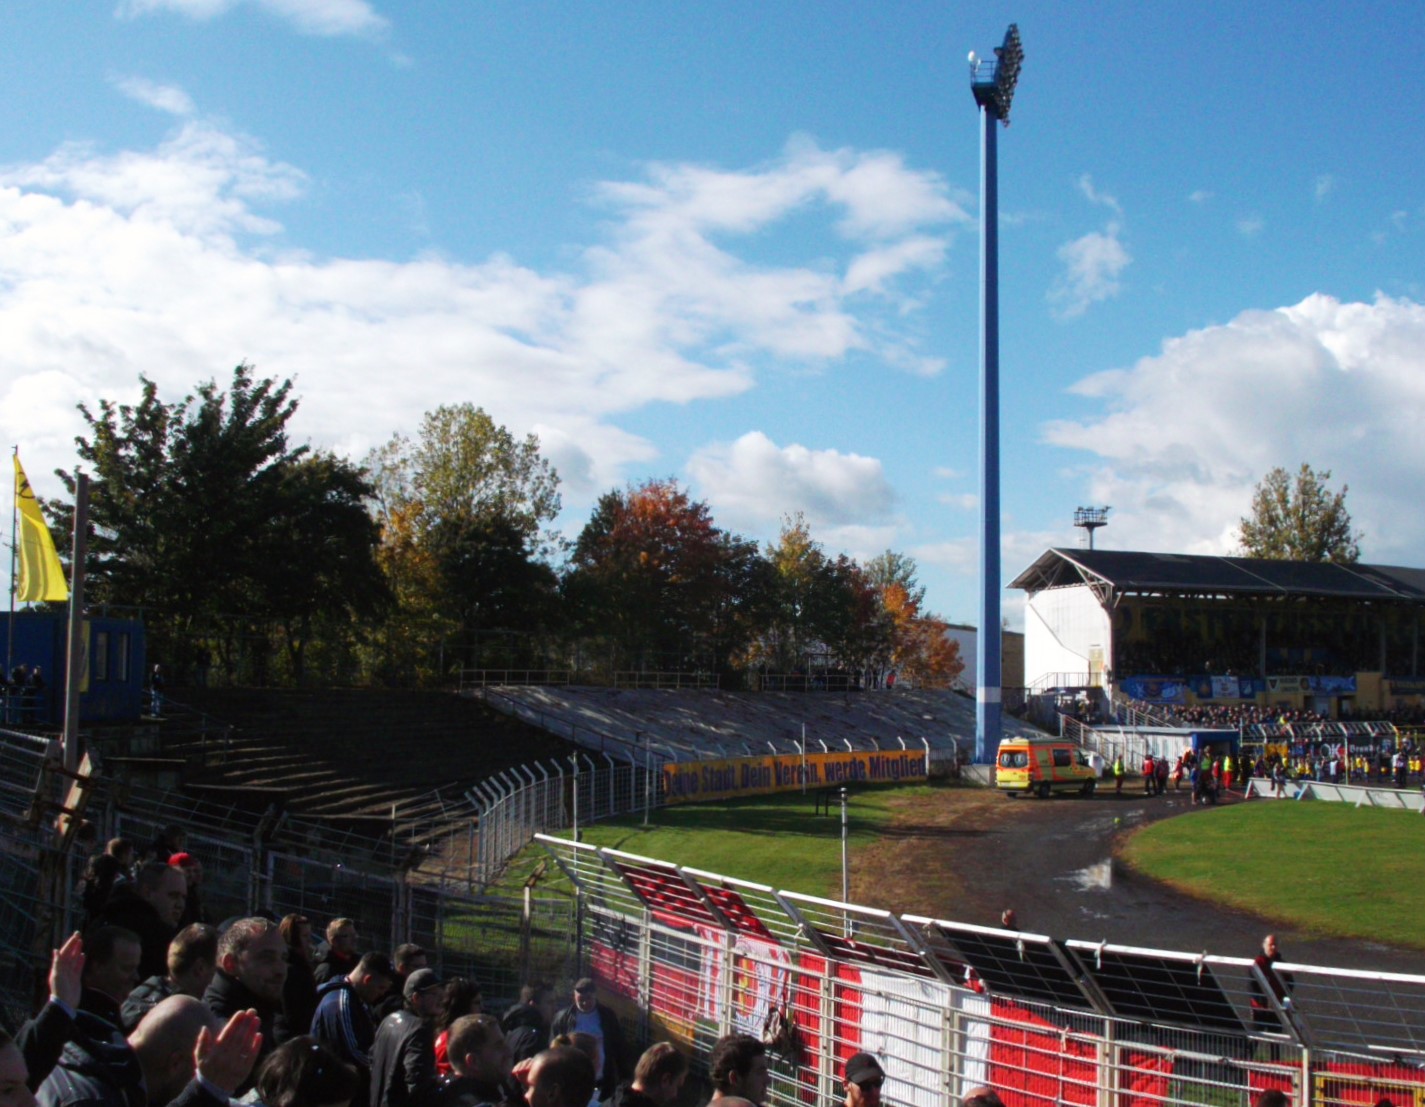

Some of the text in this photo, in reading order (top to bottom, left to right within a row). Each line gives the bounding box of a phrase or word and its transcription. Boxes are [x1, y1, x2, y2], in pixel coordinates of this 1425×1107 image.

[741, 762, 771, 789] Dein
[824, 757, 866, 782] werde
[869, 754, 926, 780] Mitglied
